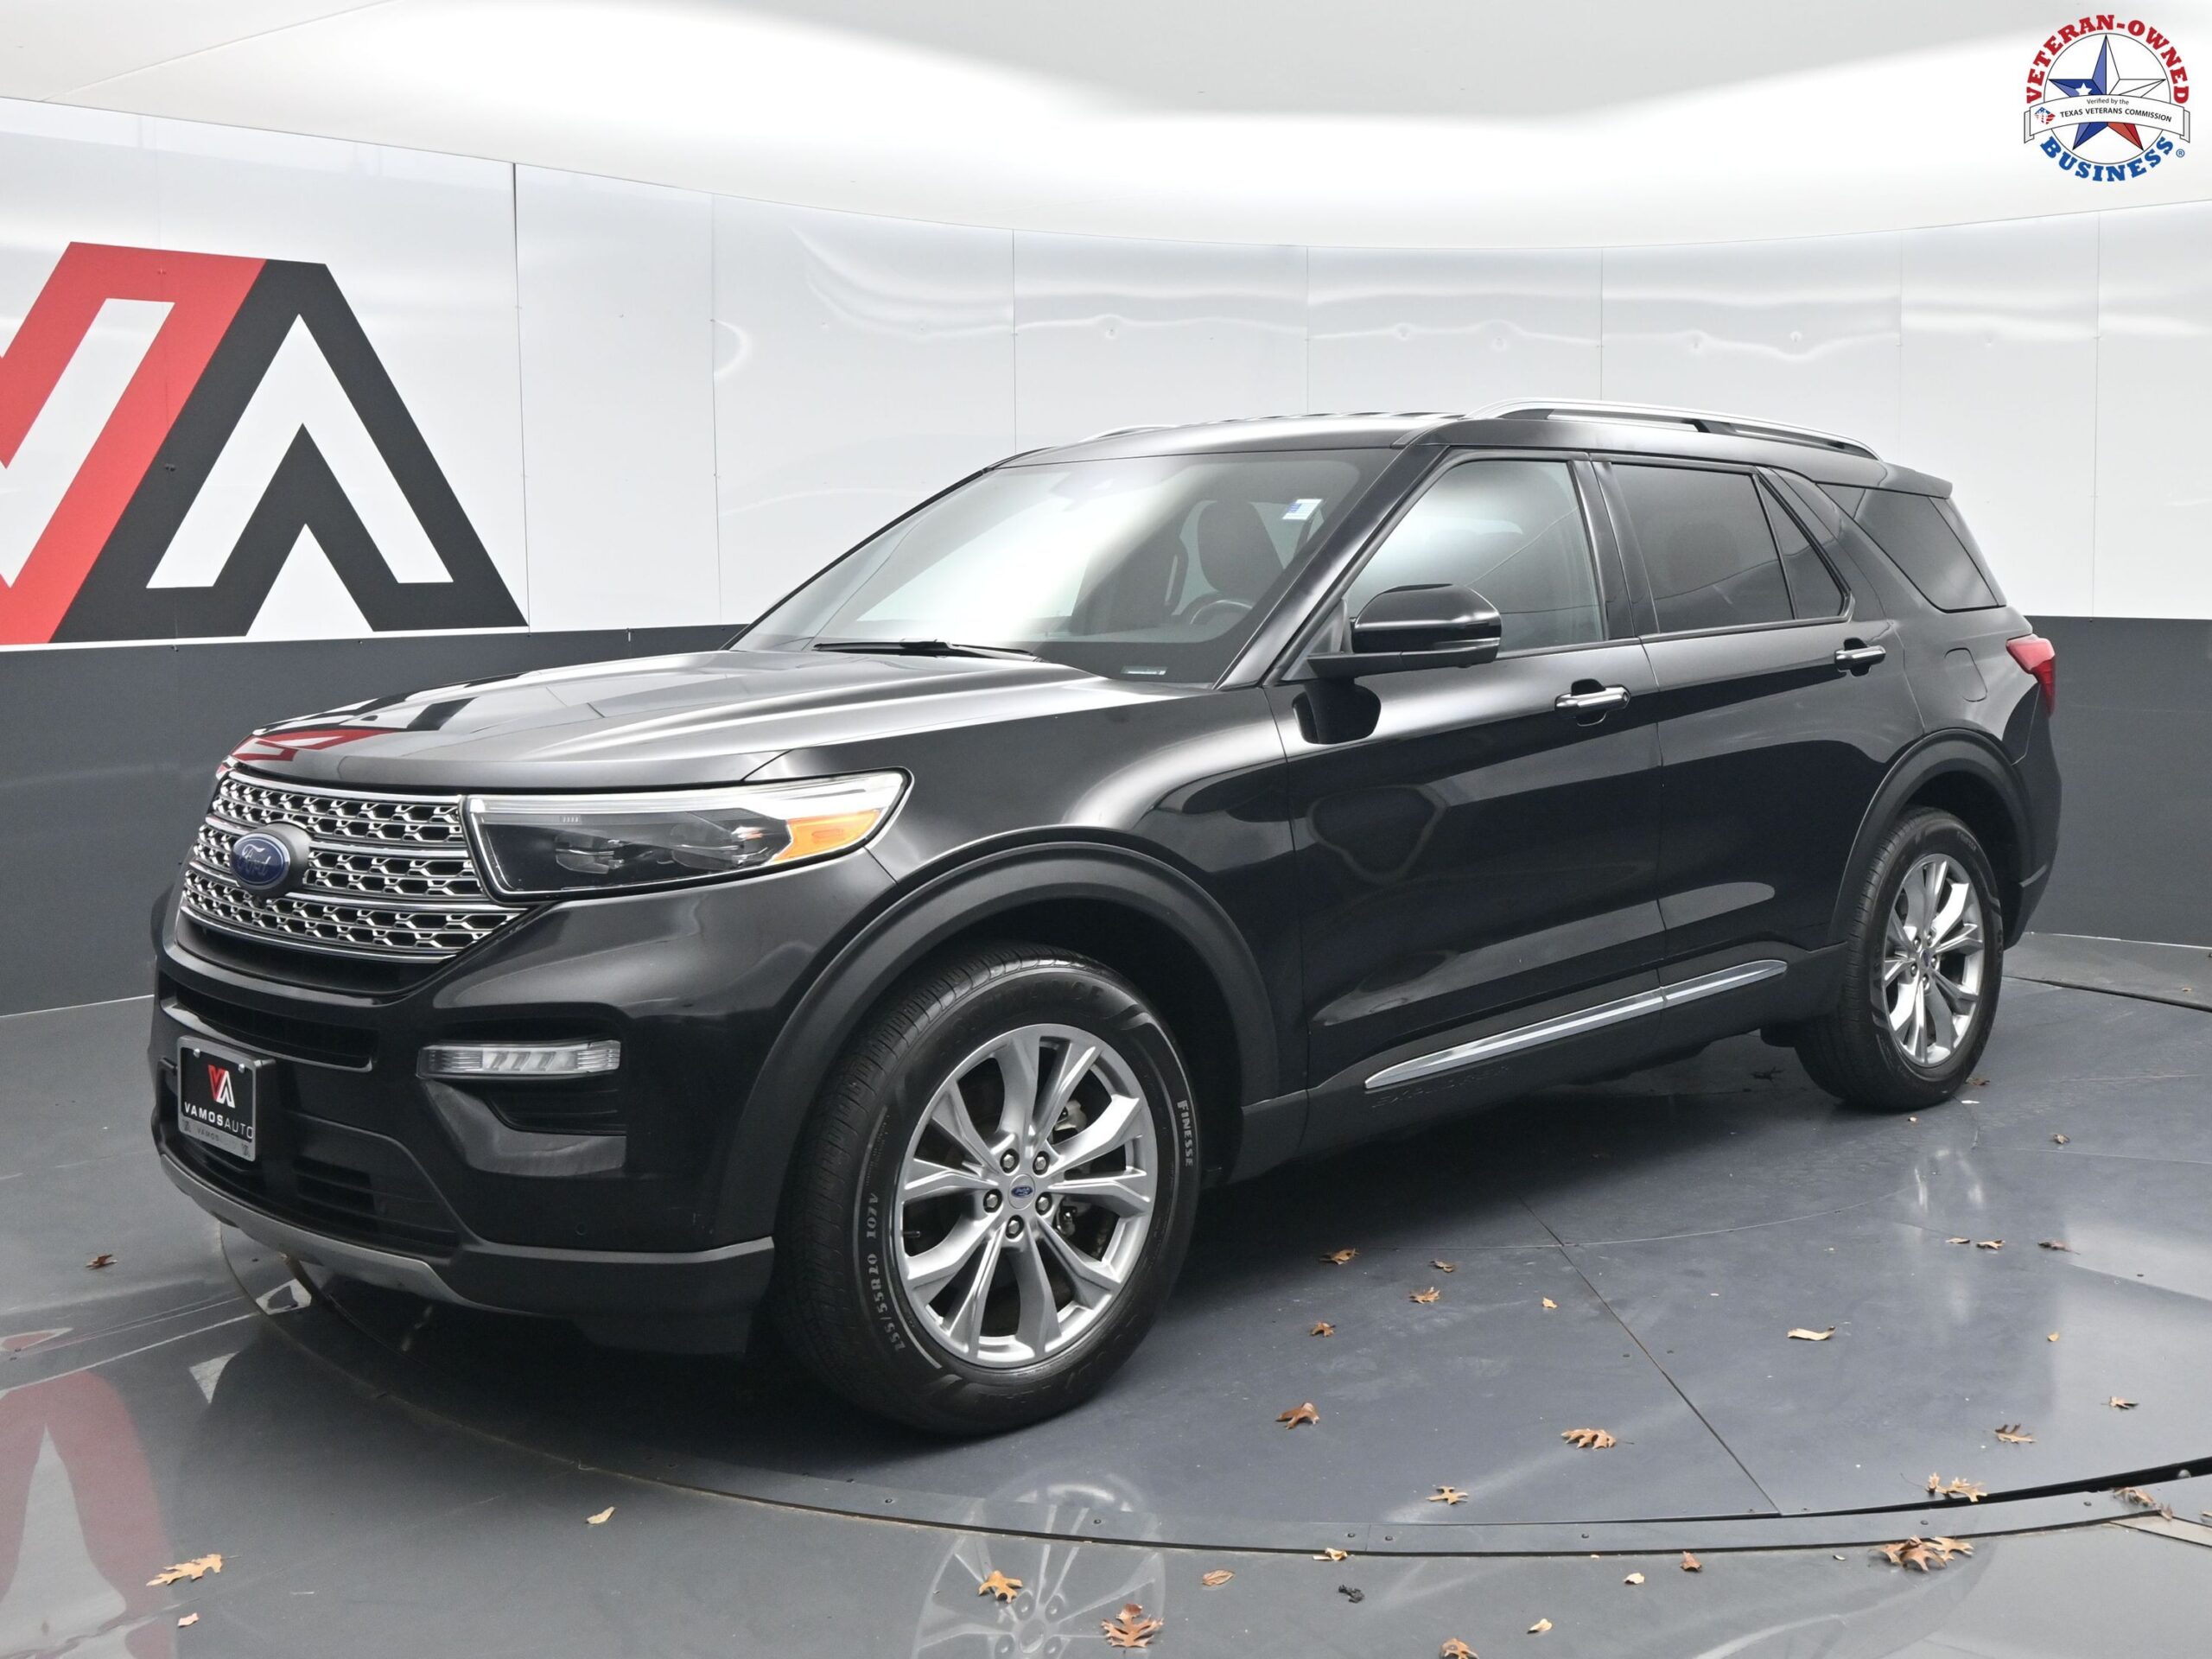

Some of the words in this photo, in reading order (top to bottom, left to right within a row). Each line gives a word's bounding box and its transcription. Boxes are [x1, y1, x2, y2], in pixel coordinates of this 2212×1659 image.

[237, 843, 273, 876] Ford
[1177, 1099, 1193, 1167] FINESSE
[866, 1192, 879, 1238] 107V
[867, 1254, 906, 1351] 255/55R20
